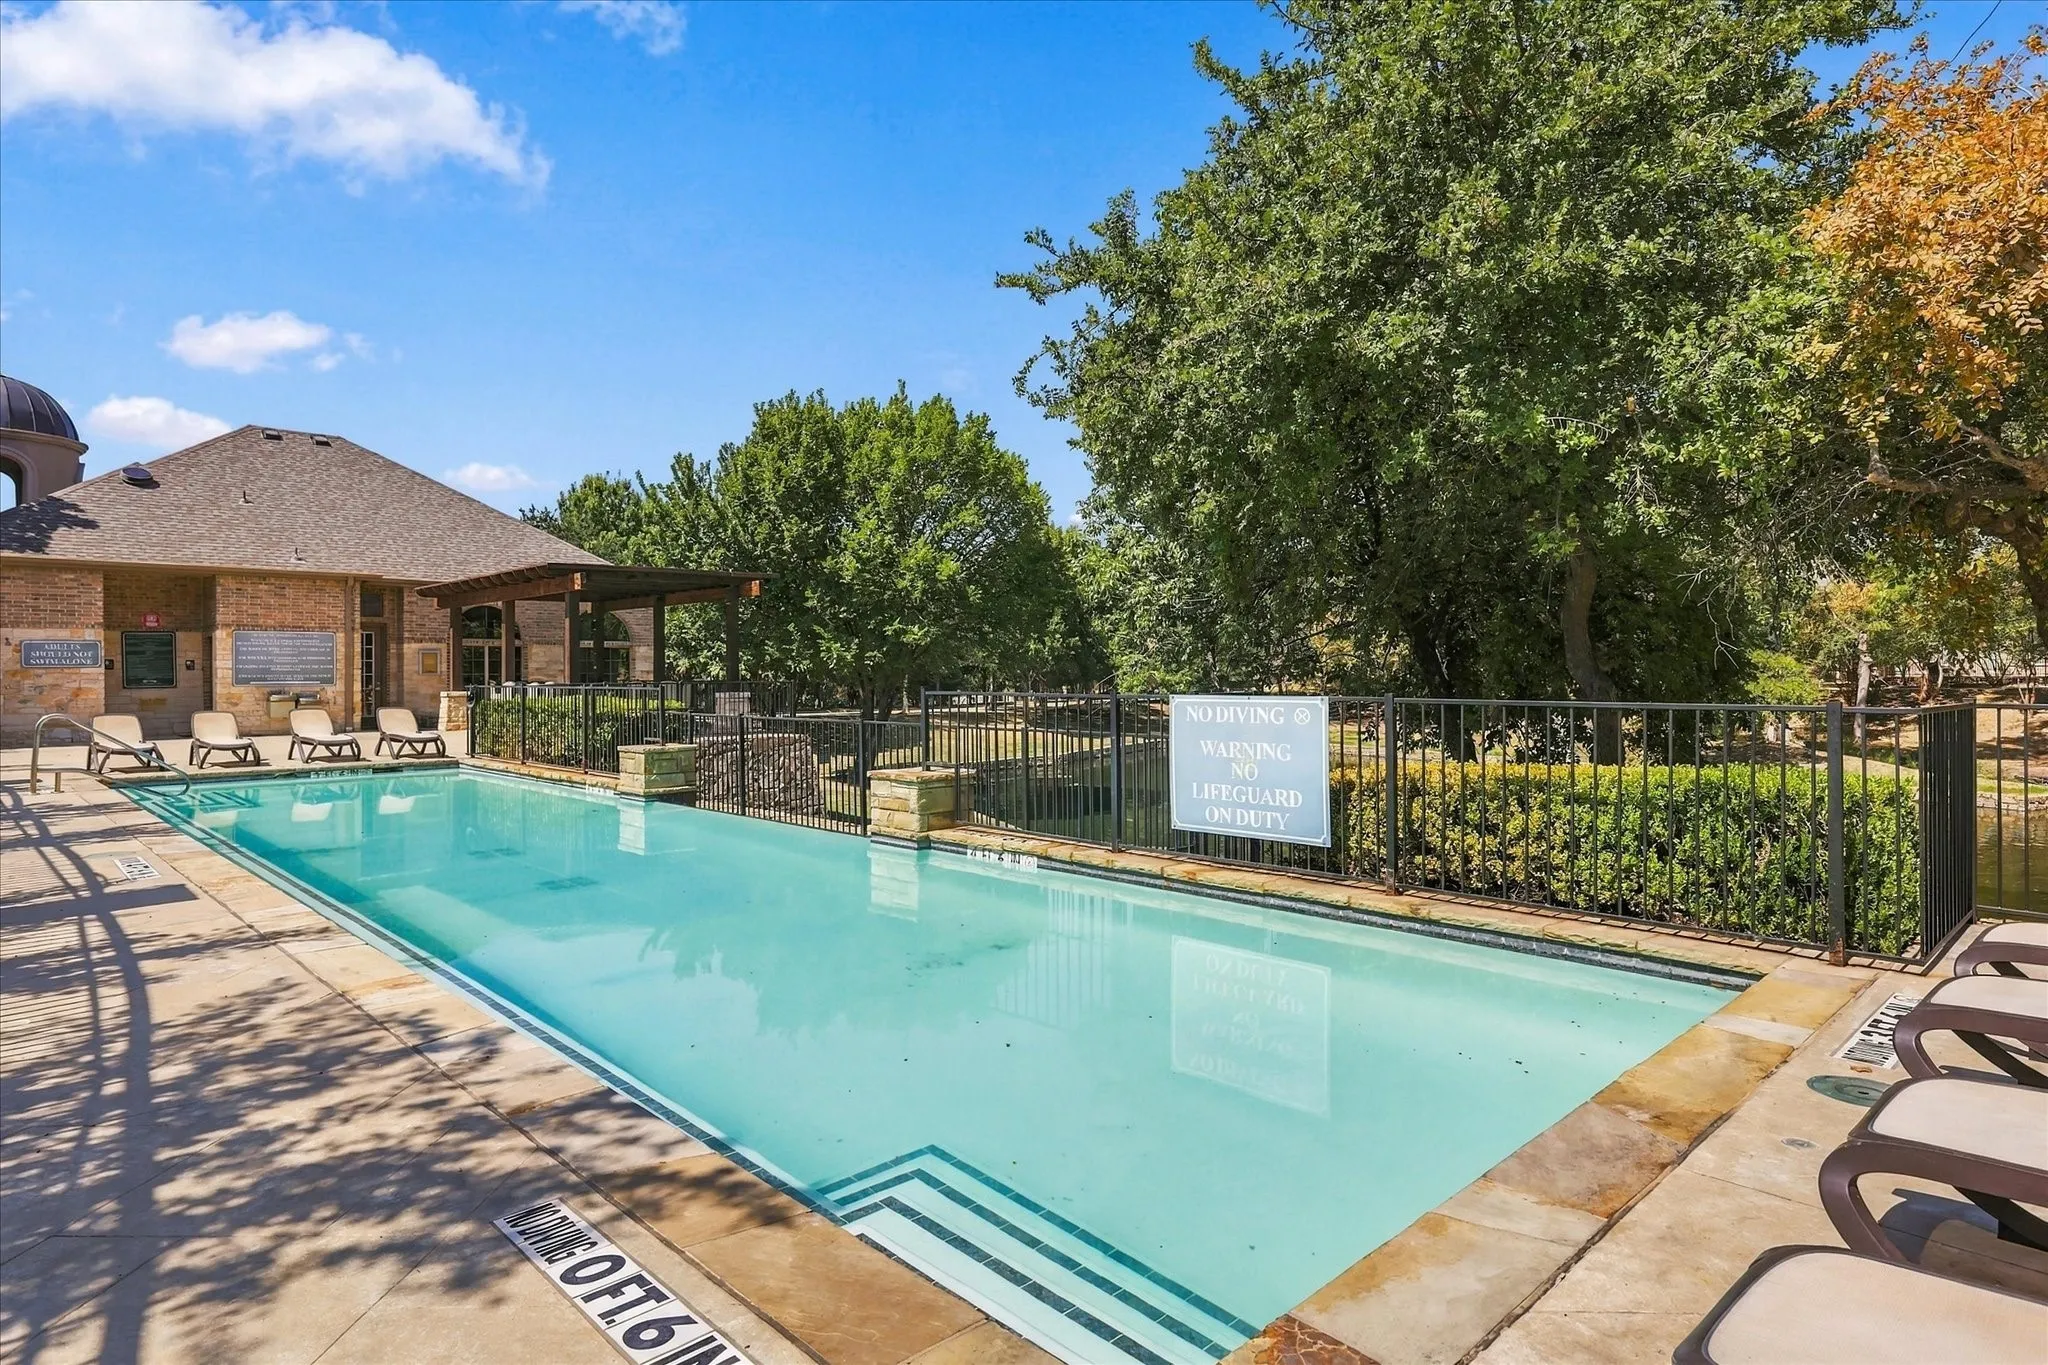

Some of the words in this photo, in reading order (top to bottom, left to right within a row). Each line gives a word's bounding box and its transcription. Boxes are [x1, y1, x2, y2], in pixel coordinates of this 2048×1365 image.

[1186, 704, 1212, 723] NO
[1215, 706, 1285, 725] DIVING
[1200, 740, 1292, 761] WARNING
[1231, 762, 1259, 781] NO
[1192, 782, 1303, 808] LIFEGUARD
[1205, 805, 1232, 825] ON
[1236, 810, 1290, 831] DUTY
[503, 1202, 562, 1229] NO
[516, 1213, 599, 1266] DIVING
[622, 1314, 699, 1350] 6
